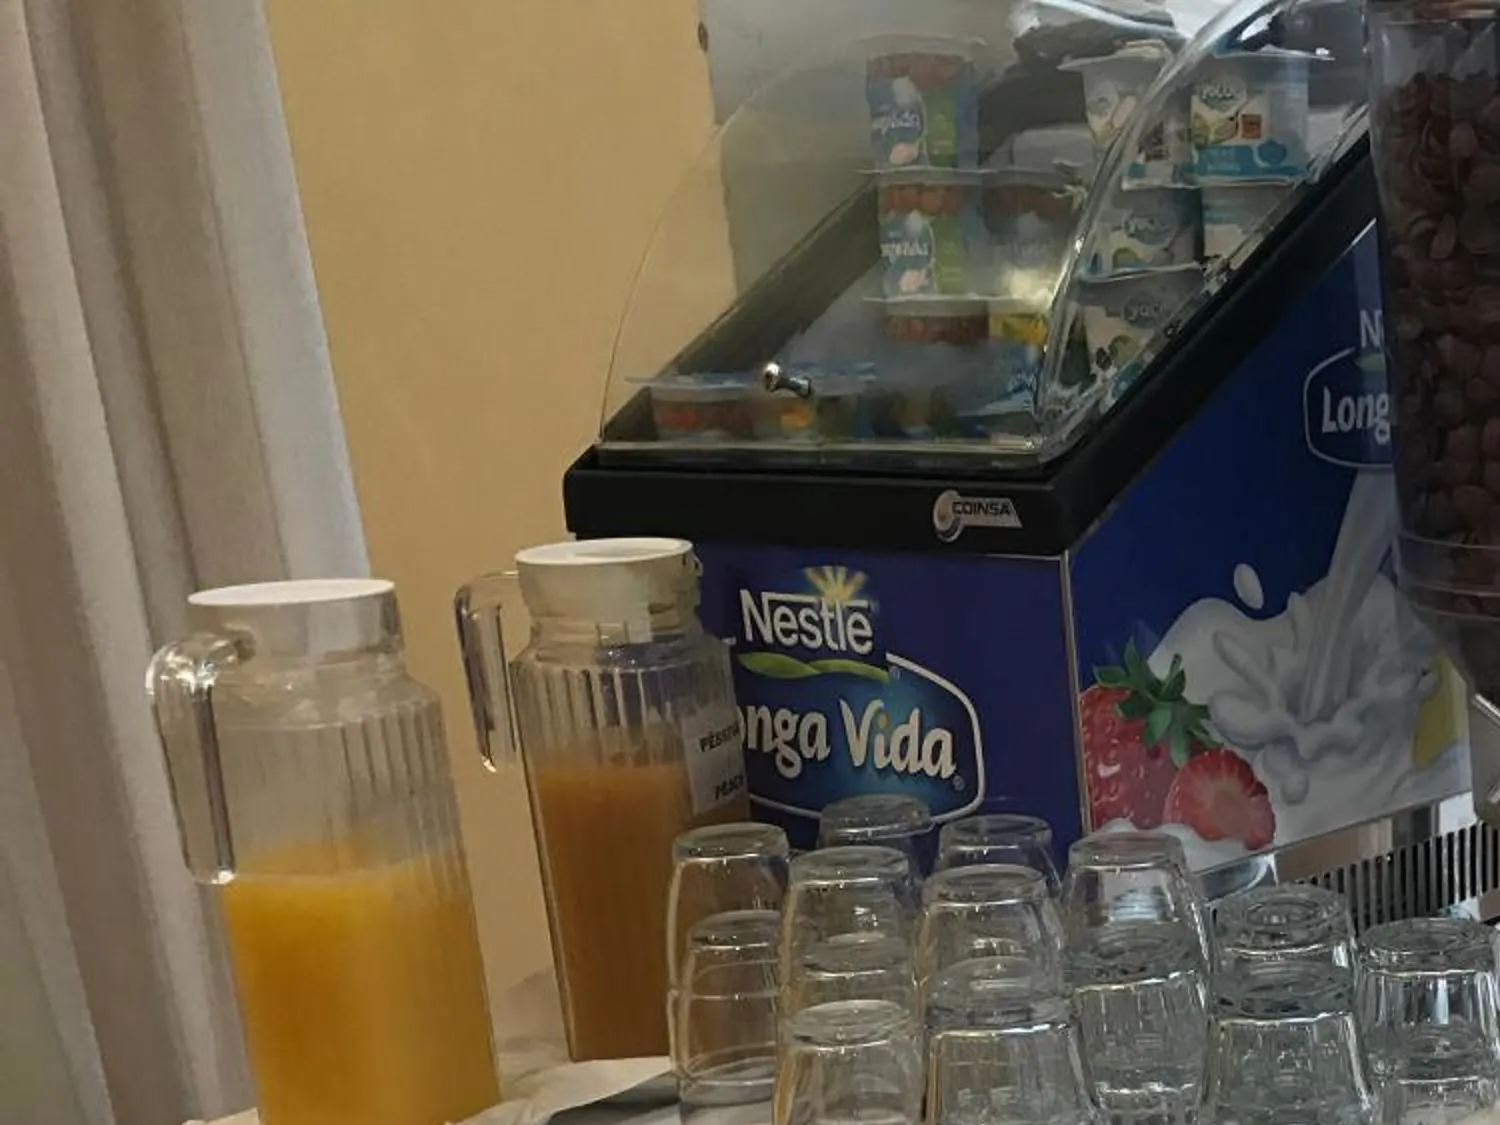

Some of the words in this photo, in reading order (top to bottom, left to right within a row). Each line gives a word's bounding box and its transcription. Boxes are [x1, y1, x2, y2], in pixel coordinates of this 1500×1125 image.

[1322, 386, 1391, 445] Long
[952, 501, 1011, 516] COINSA
[737, 704, 831, 779] nga
[839, 699, 957, 780] Vida
